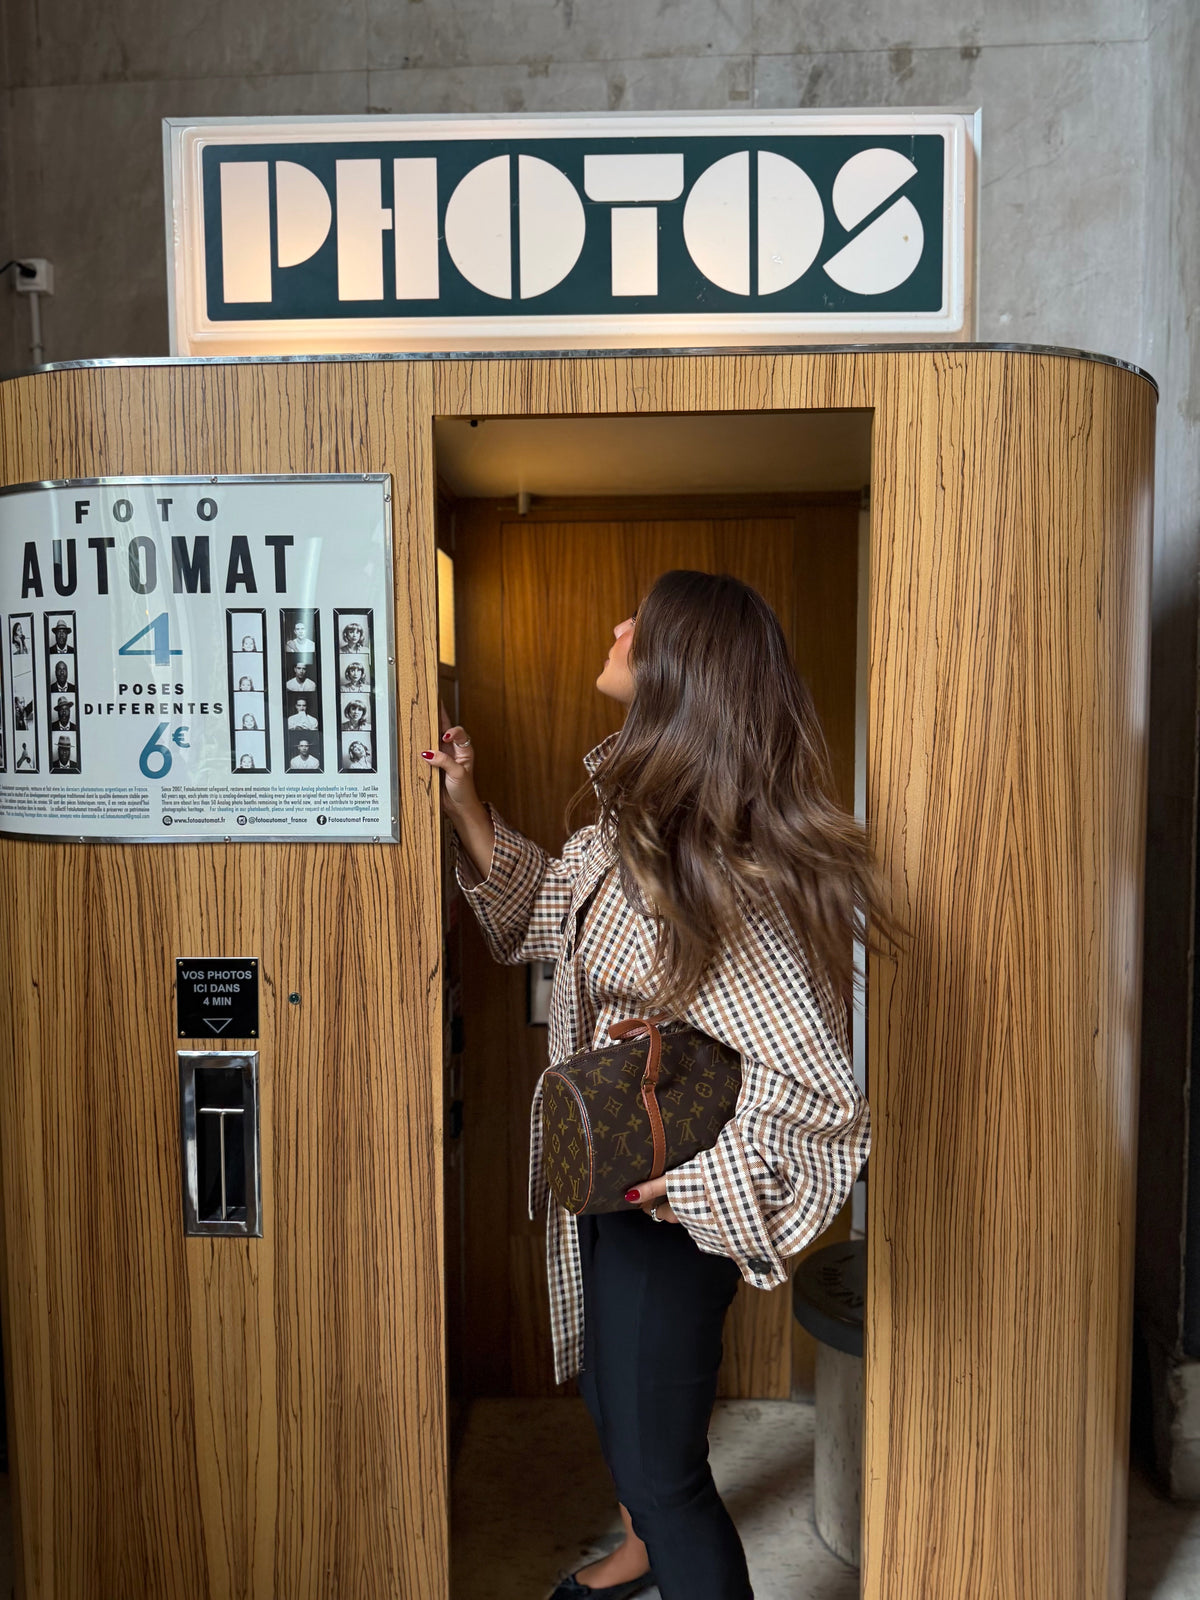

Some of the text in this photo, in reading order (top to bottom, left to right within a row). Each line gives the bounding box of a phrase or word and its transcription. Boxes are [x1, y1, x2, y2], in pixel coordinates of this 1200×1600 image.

[219, 147, 925, 305] PHOTOS
[75, 497, 218, 524] FOTO
[21, 535, 294, 599] AUTOMAT
[119, 612, 183, 666] 4
[119, 683, 185, 696] POSES
[84, 703, 223, 715] DIFFERENTES
[139, 722, 191, 779] 6€
[174, 816, 226, 824] www.fotoautomat.fr
[248, 816, 308, 825] @fotoautomat_france
[182, 970, 253, 980] VOS PHOTOS
[193, 983, 241, 993] ICI DANS
[203, 996, 232, 1006] 4 MIN
